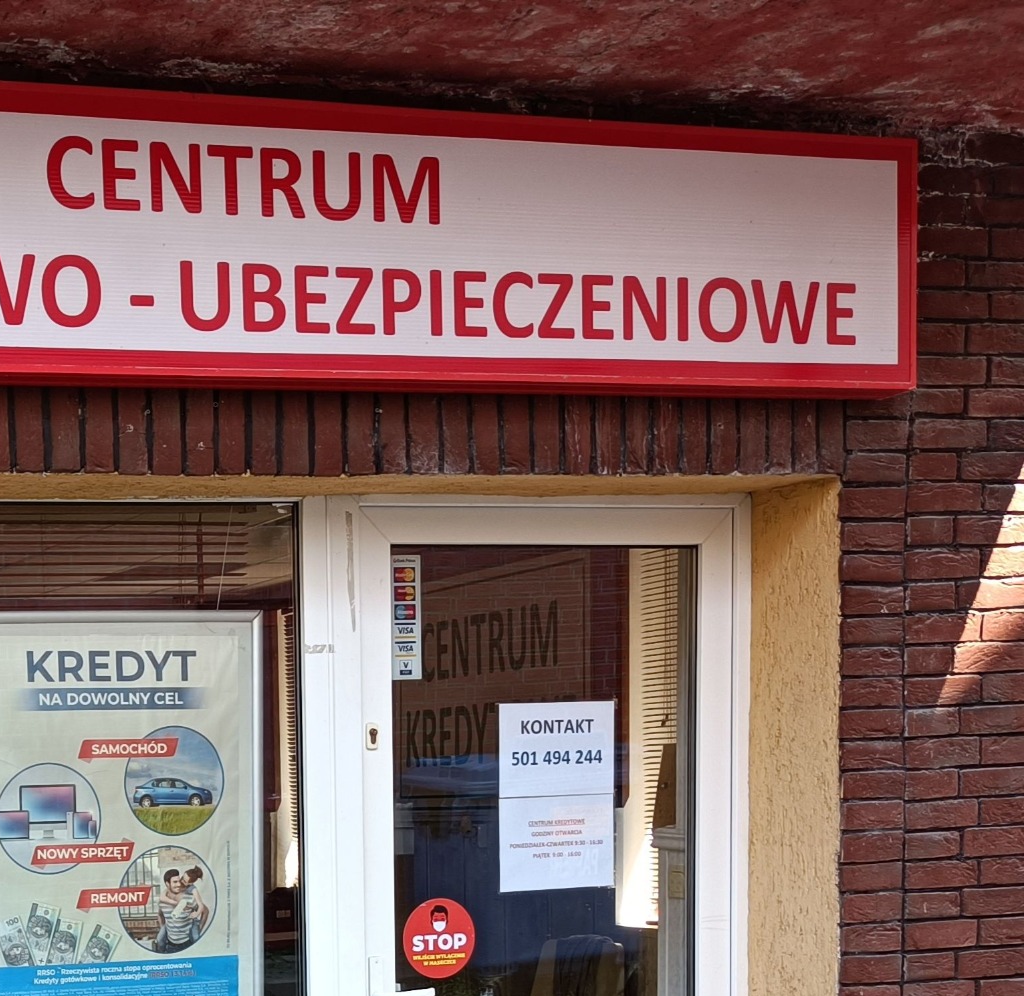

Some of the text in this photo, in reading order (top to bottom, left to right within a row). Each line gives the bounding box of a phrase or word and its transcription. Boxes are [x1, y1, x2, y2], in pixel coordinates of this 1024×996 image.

[48, 135, 441, 225] CENTRUM
[179, 261, 857, 346] UBEZPIECZENIOWE
[26, 650, 197, 683] KREDYT
[39, 692, 184, 706] NA DOWOLNY CEL
[521, 718, 594, 735] KONTAKT
[91, 741, 168, 755] SAMOCHÓD
[511, 750, 603, 766] 501 494 244
[37, 846, 129, 860] NOWY SPRZĘT
[90, 891, 145, 904] REMONT
[412, 932, 467, 952] STOP
[34, 977, 59, 986] Kredyty
